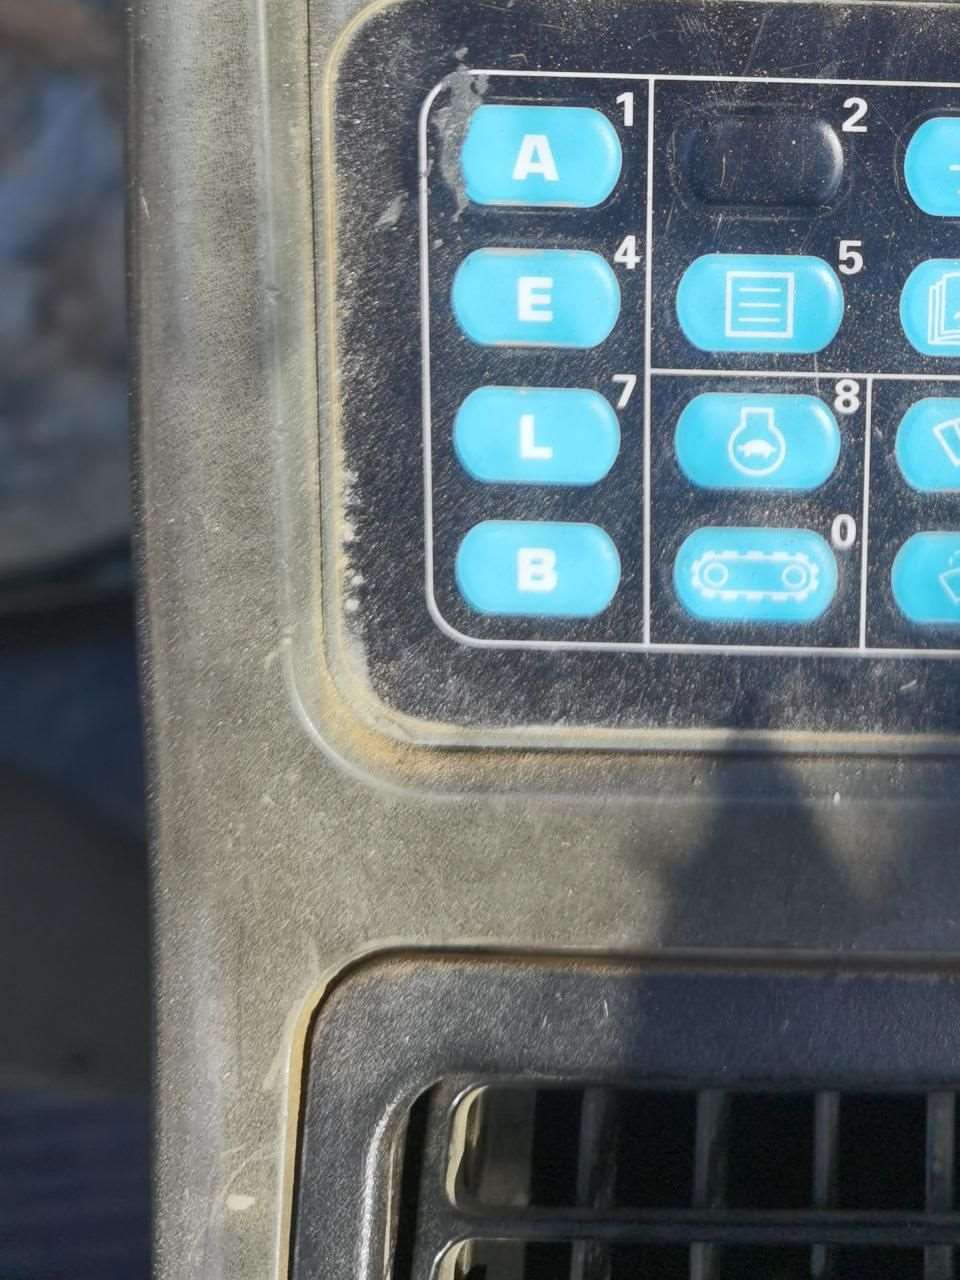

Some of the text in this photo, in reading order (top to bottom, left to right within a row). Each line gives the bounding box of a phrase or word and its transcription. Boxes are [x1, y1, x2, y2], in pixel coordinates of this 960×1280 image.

[615, 91, 634, 127] 1
[841, 96, 868, 133] 2
[511, 134, 560, 182] A
[613, 234, 641, 270] 4
[838, 239, 864, 276] 5
[516, 275, 553, 322] E
[611, 373, 637, 409] 7
[833, 378, 861, 415] 8
[518, 414, 553, 461] L
[516, 547, 558, 593] B
